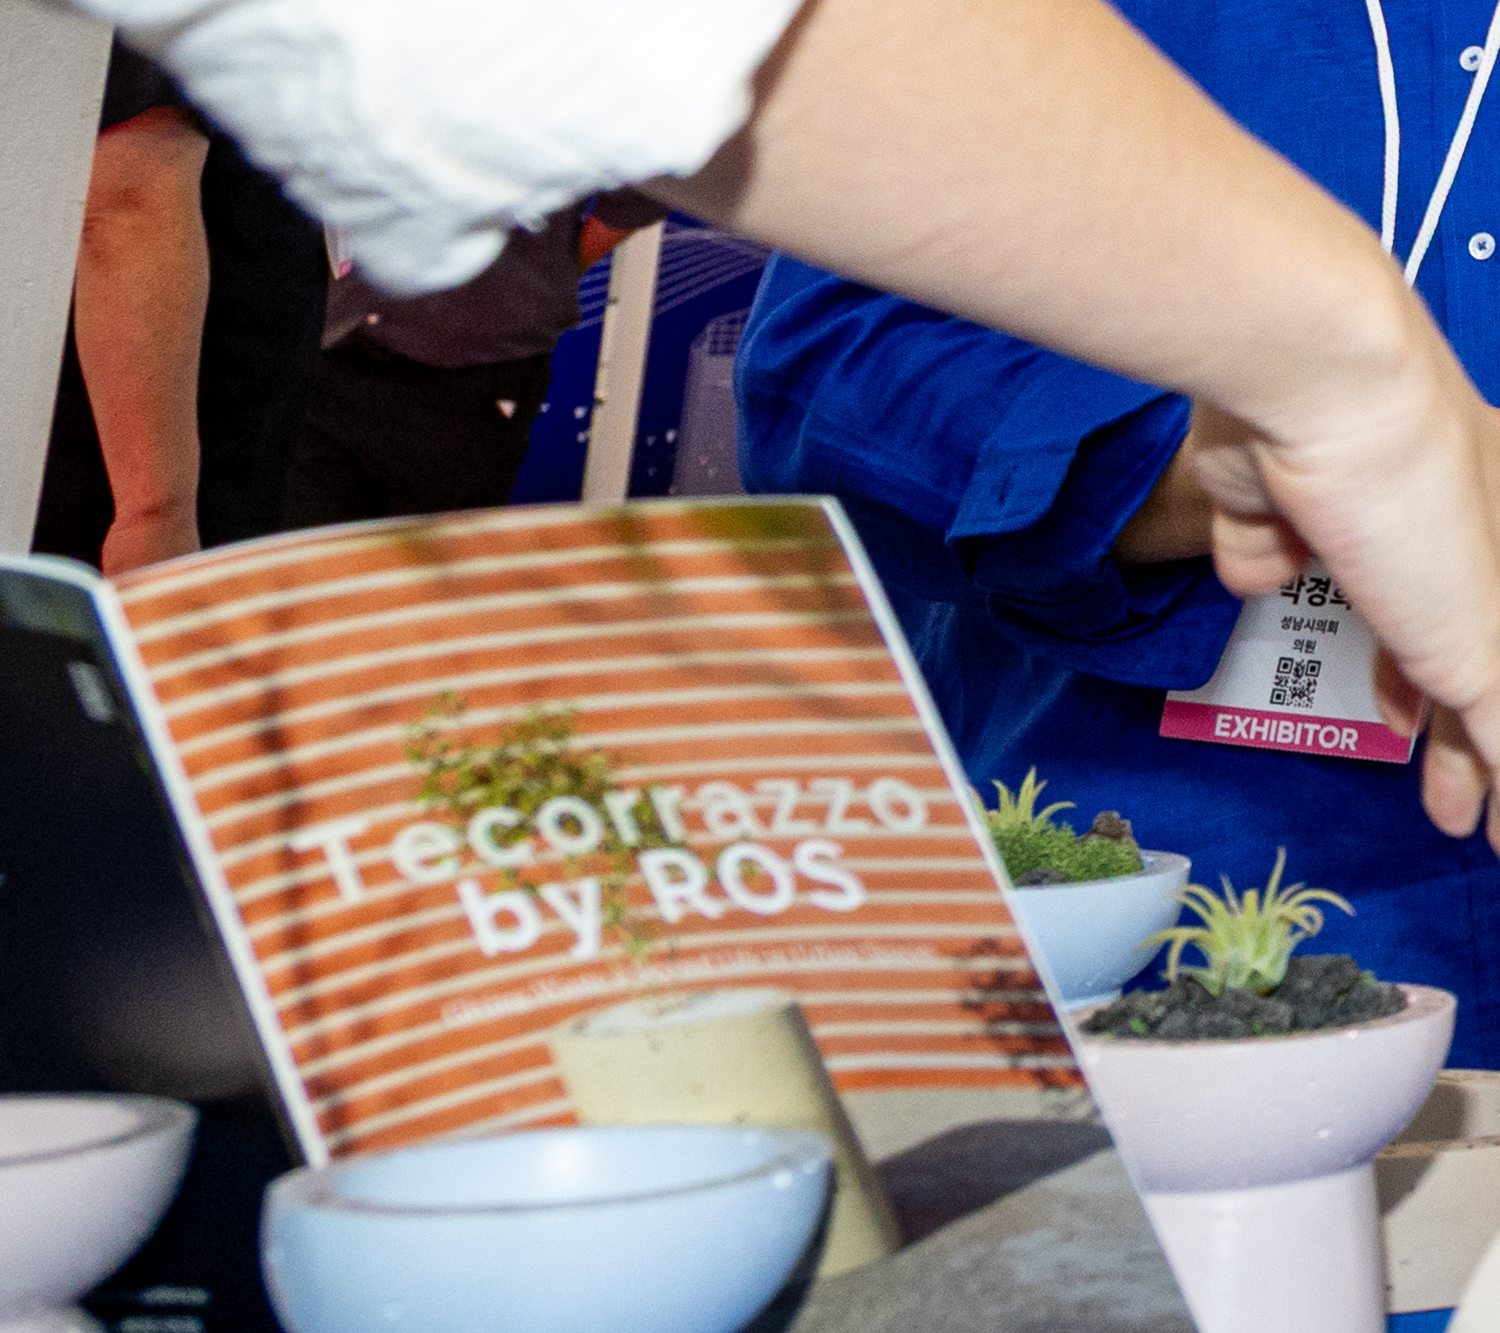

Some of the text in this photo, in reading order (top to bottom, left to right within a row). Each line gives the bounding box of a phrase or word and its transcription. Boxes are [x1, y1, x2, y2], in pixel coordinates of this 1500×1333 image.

[1280, 615, 1341, 636] 성남시의회
[1292, 637, 1318, 655] 의원
[1213, 713, 1360, 752] EXHIBITOR
[287, 776, 929, 906] Tecorrazzo
[456, 839, 868, 961] by ROS
